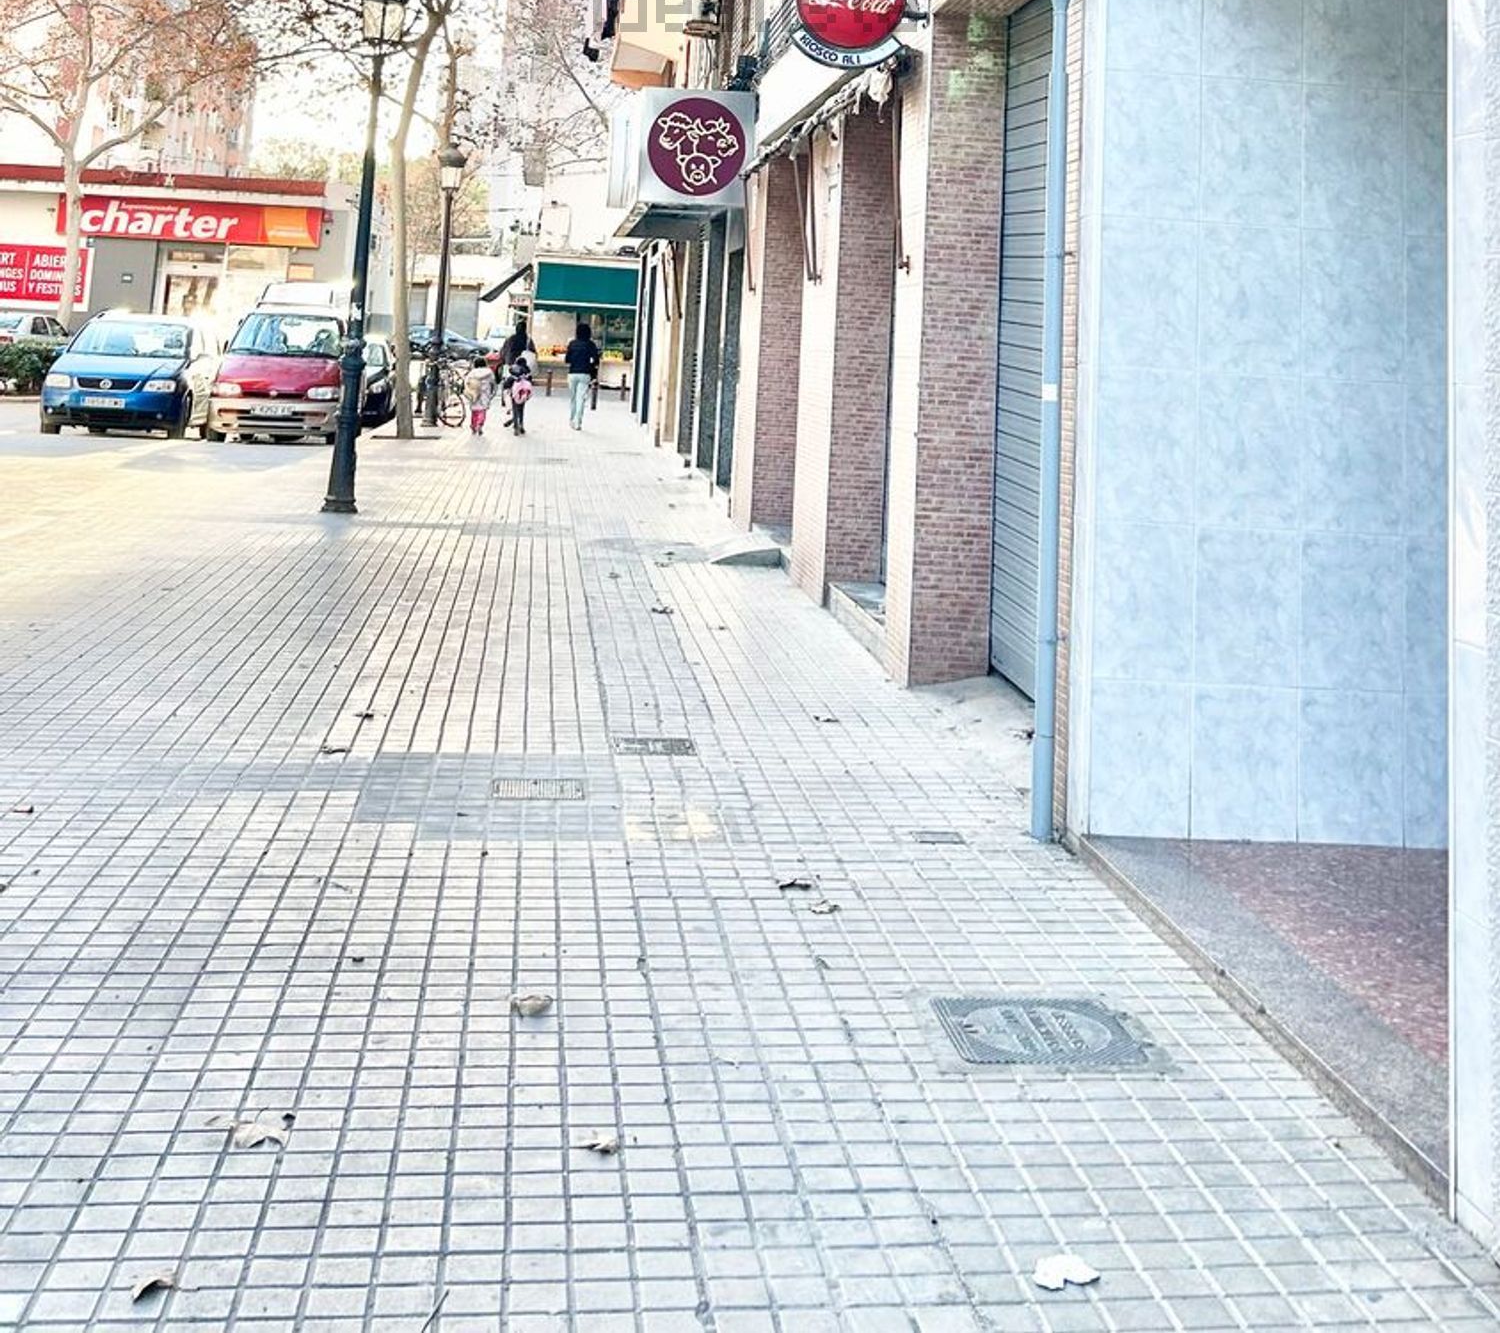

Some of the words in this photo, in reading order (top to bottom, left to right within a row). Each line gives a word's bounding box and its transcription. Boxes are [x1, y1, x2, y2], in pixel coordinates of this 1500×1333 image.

[799, 33, 838, 62] KIOSCO
[842, 55, 861, 65] ALI
[79, 200, 239, 239] charter
[32, 253, 81, 269] ABIER
[30, 269, 81, 284] DOMINS
[28, 282, 35, 293] Y
